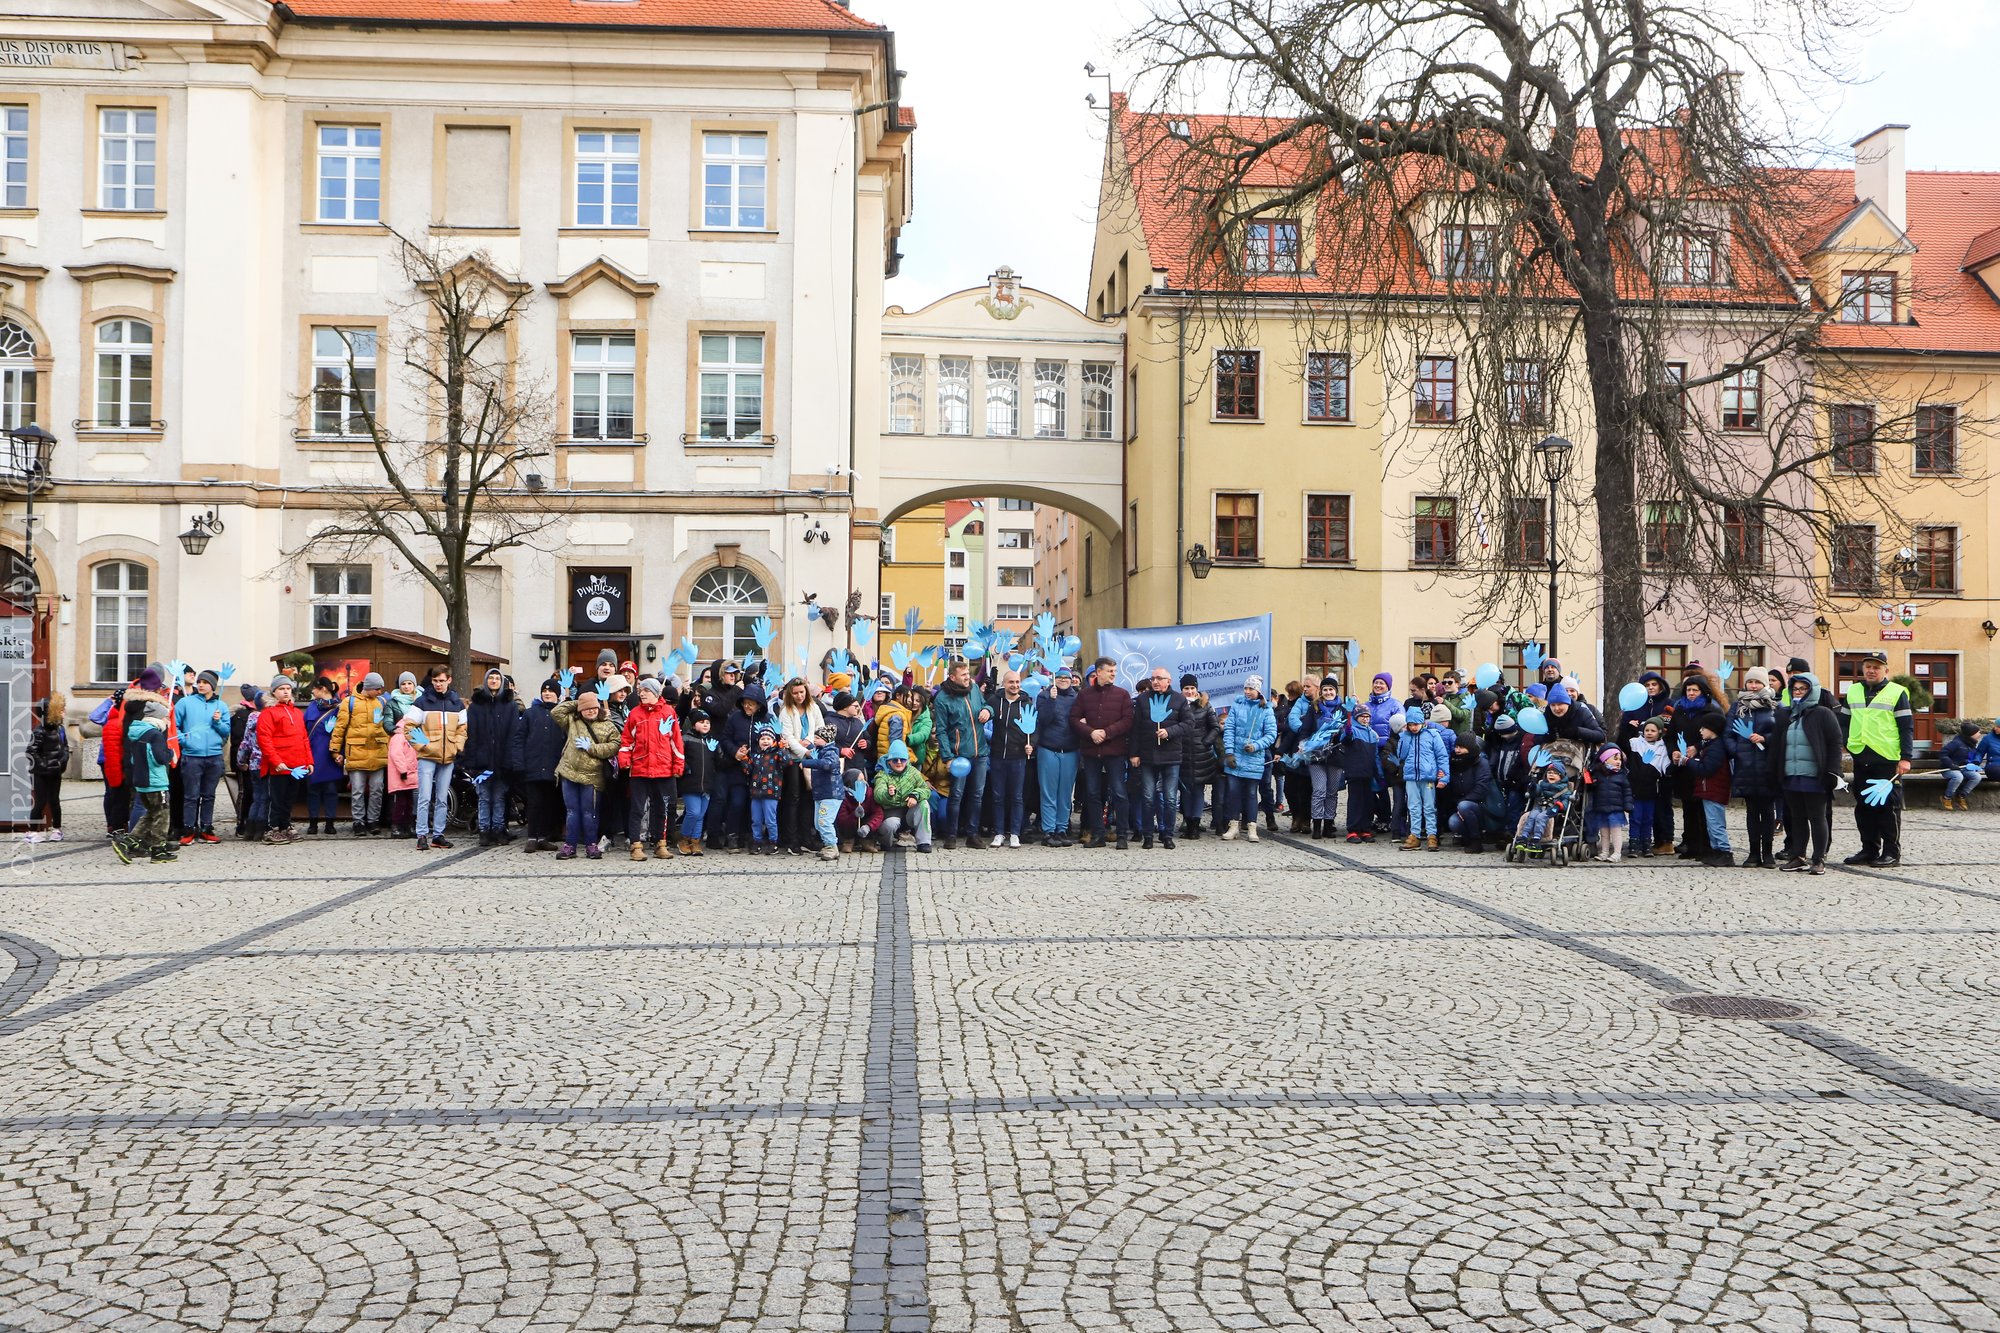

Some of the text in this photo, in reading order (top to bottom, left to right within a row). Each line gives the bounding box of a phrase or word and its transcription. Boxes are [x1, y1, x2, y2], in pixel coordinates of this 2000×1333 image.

[0, 41, 102, 55] US DISTORTUS
[1175, 629, 1261, 650] 2 KWIETNIA
[1178, 652, 1260, 673] ŚWIATOWY DZIEŃ
[1227, 665, 1259, 676] AUTYZMU
